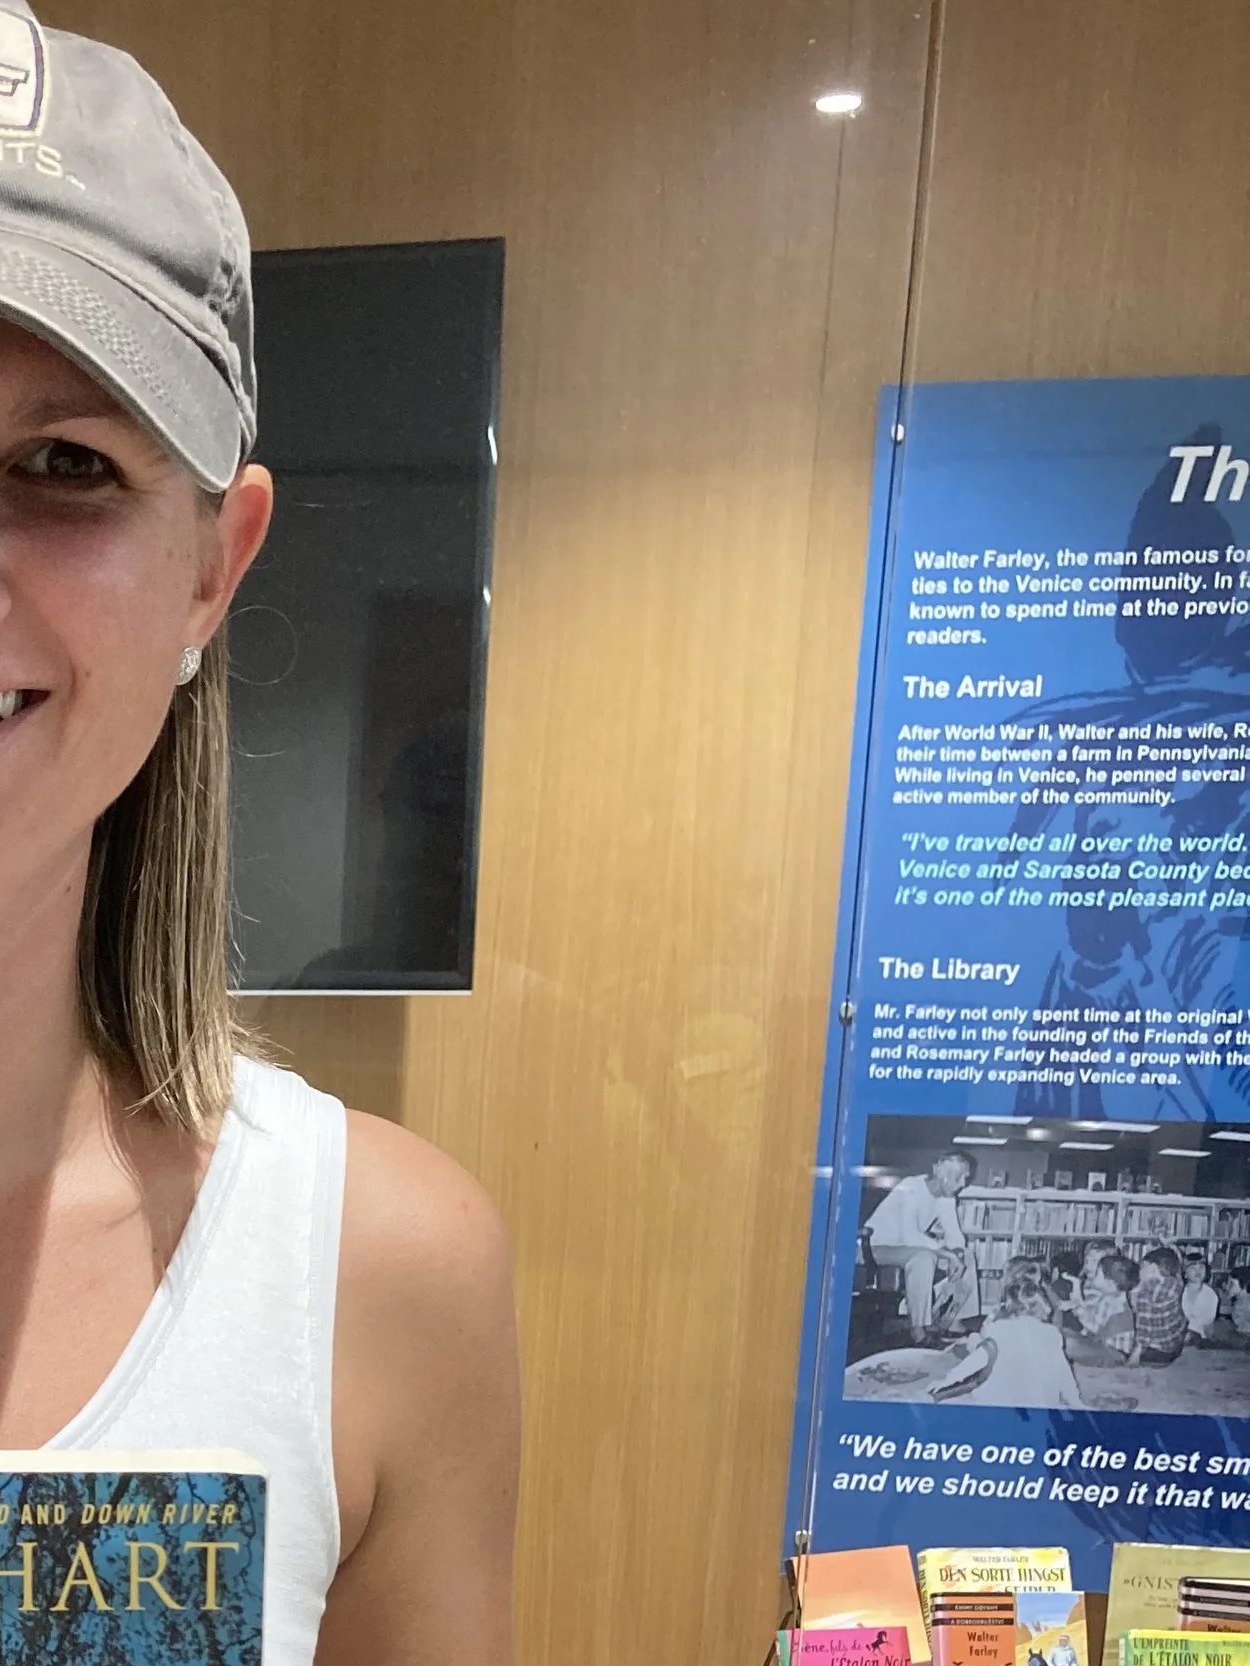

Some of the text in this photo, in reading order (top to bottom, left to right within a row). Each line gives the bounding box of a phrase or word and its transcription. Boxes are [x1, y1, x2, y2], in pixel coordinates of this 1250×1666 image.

[1169, 445, 1250, 502] Th
[914, 546, 1219, 571] Walter Farley, the man famous
[912, 571, 1233, 595] ties to the Venice community. In
[910, 601, 975, 620] known
[980, 601, 1001, 619] to
[1006, 599, 1068, 622] spend
[1073, 598, 1117, 617] time
[1121, 599, 1142, 617] at
[1147, 598, 1179, 616] the
[907, 626, 987, 645] readers.
[903, 674, 1043, 699] The Arrival
[898, 722, 1228, 742] After World War II, Walter and his wife,
[896, 746, 936, 762] their
[940, 746, 976, 762] time
[980, 746, 1052, 762] between
[1057, 749, 1067, 762] a
[1072, 745, 1111, 761] farm
[895, 766, 1246, 786] While living Venice, he penned several
[892, 787, 1176, 807] active member community.
[955, 832, 1247, 852] traveled all over the world.
[899, 859, 1210, 884] Venice and Sarasota County
[934, 886, 1207, 911] one of the most pleasant
[878, 957, 1020, 985] The Library
[874, 1003, 1243, 1028] Mr. Farley not only spent time original
[872, 1024, 1208, 1046] and active founding Friends
[870, 1044, 1221, 1067] and Rosemary Farley headed group with
[869, 1064, 1182, 1086] for rapidly expanding Venice area.
[839, 1434, 897, 1459] “We
[904, 1437, 973, 1462] have
[981, 1444, 1035, 1466] one
[1043, 1443, 1076, 1467] of
[1080, 1445, 1126, 1470] the
[1134, 1447, 1200, 1474] best
[832, 1469, 1214, 1510] and we should keep it that
[20, 1503, 66, 1525] AND
[81, 1503, 152, 1525] DOWN
[162, 1502, 239, 1525] RIVER
[967, 1631, 998, 1642] Walter
[969, 1645, 998, 1659] Farley
